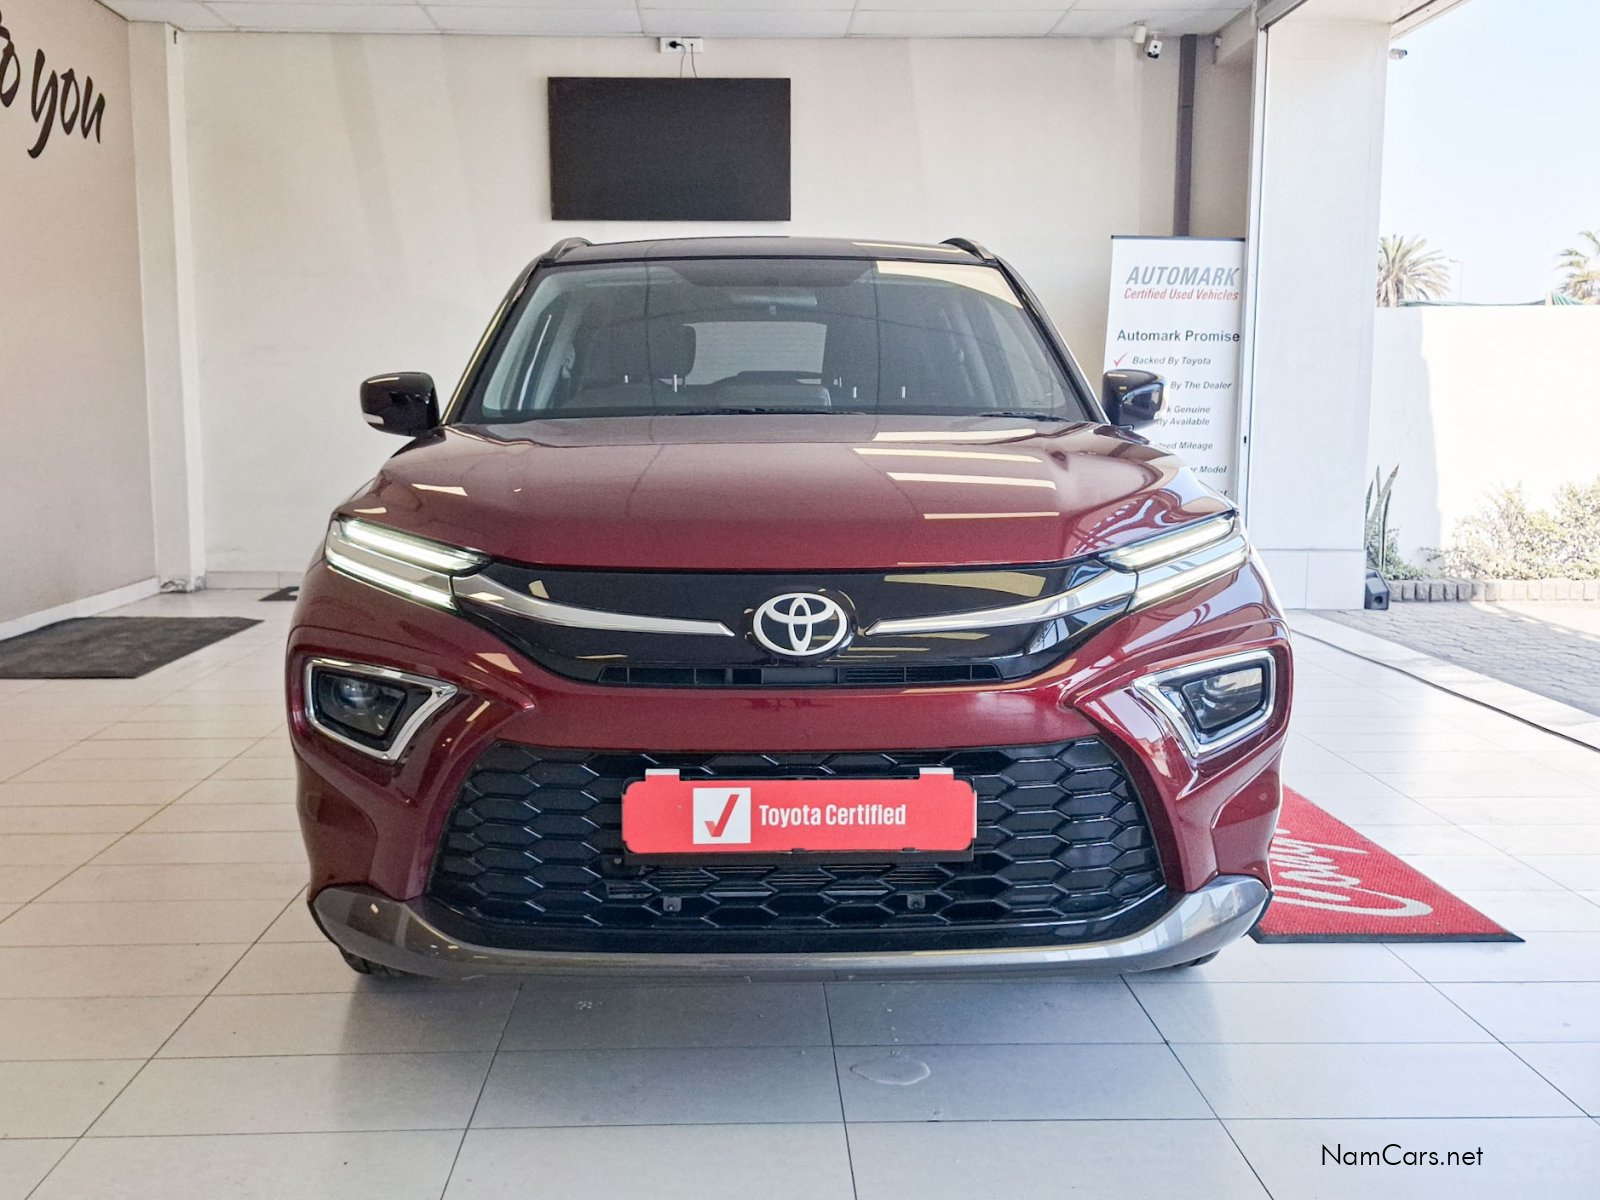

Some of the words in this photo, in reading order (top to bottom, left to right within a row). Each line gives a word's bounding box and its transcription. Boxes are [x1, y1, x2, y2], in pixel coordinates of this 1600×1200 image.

[0, 10, 21, 108] o
[27, 48, 106, 159] you
[1126, 266, 1240, 286] AUTOMARK
[1124, 287, 1167, 300] Certified
[1169, 288, 1194, 300] Used
[1196, 289, 1240, 301] Vehicles
[1117, 329, 1181, 341] Automark
[1185, 330, 1241, 342] Promise
[1132, 356, 1166, 365] Backed
[1168, 356, 1179, 367] By
[1182, 357, 1212, 367] Toyota
[1170, 381, 1182, 390] By
[1184, 381, 1201, 389] The
[1203, 381, 1233, 389] Dealer
[1174, 405, 1211, 414] Genuine
[1169, 417, 1210, 426] Available
[1178, 441, 1213, 452] Mileage
[1199, 465, 1228, 473] Model
[759, 804, 822, 828] Toyota
[825, 803, 906, 826] Certified
